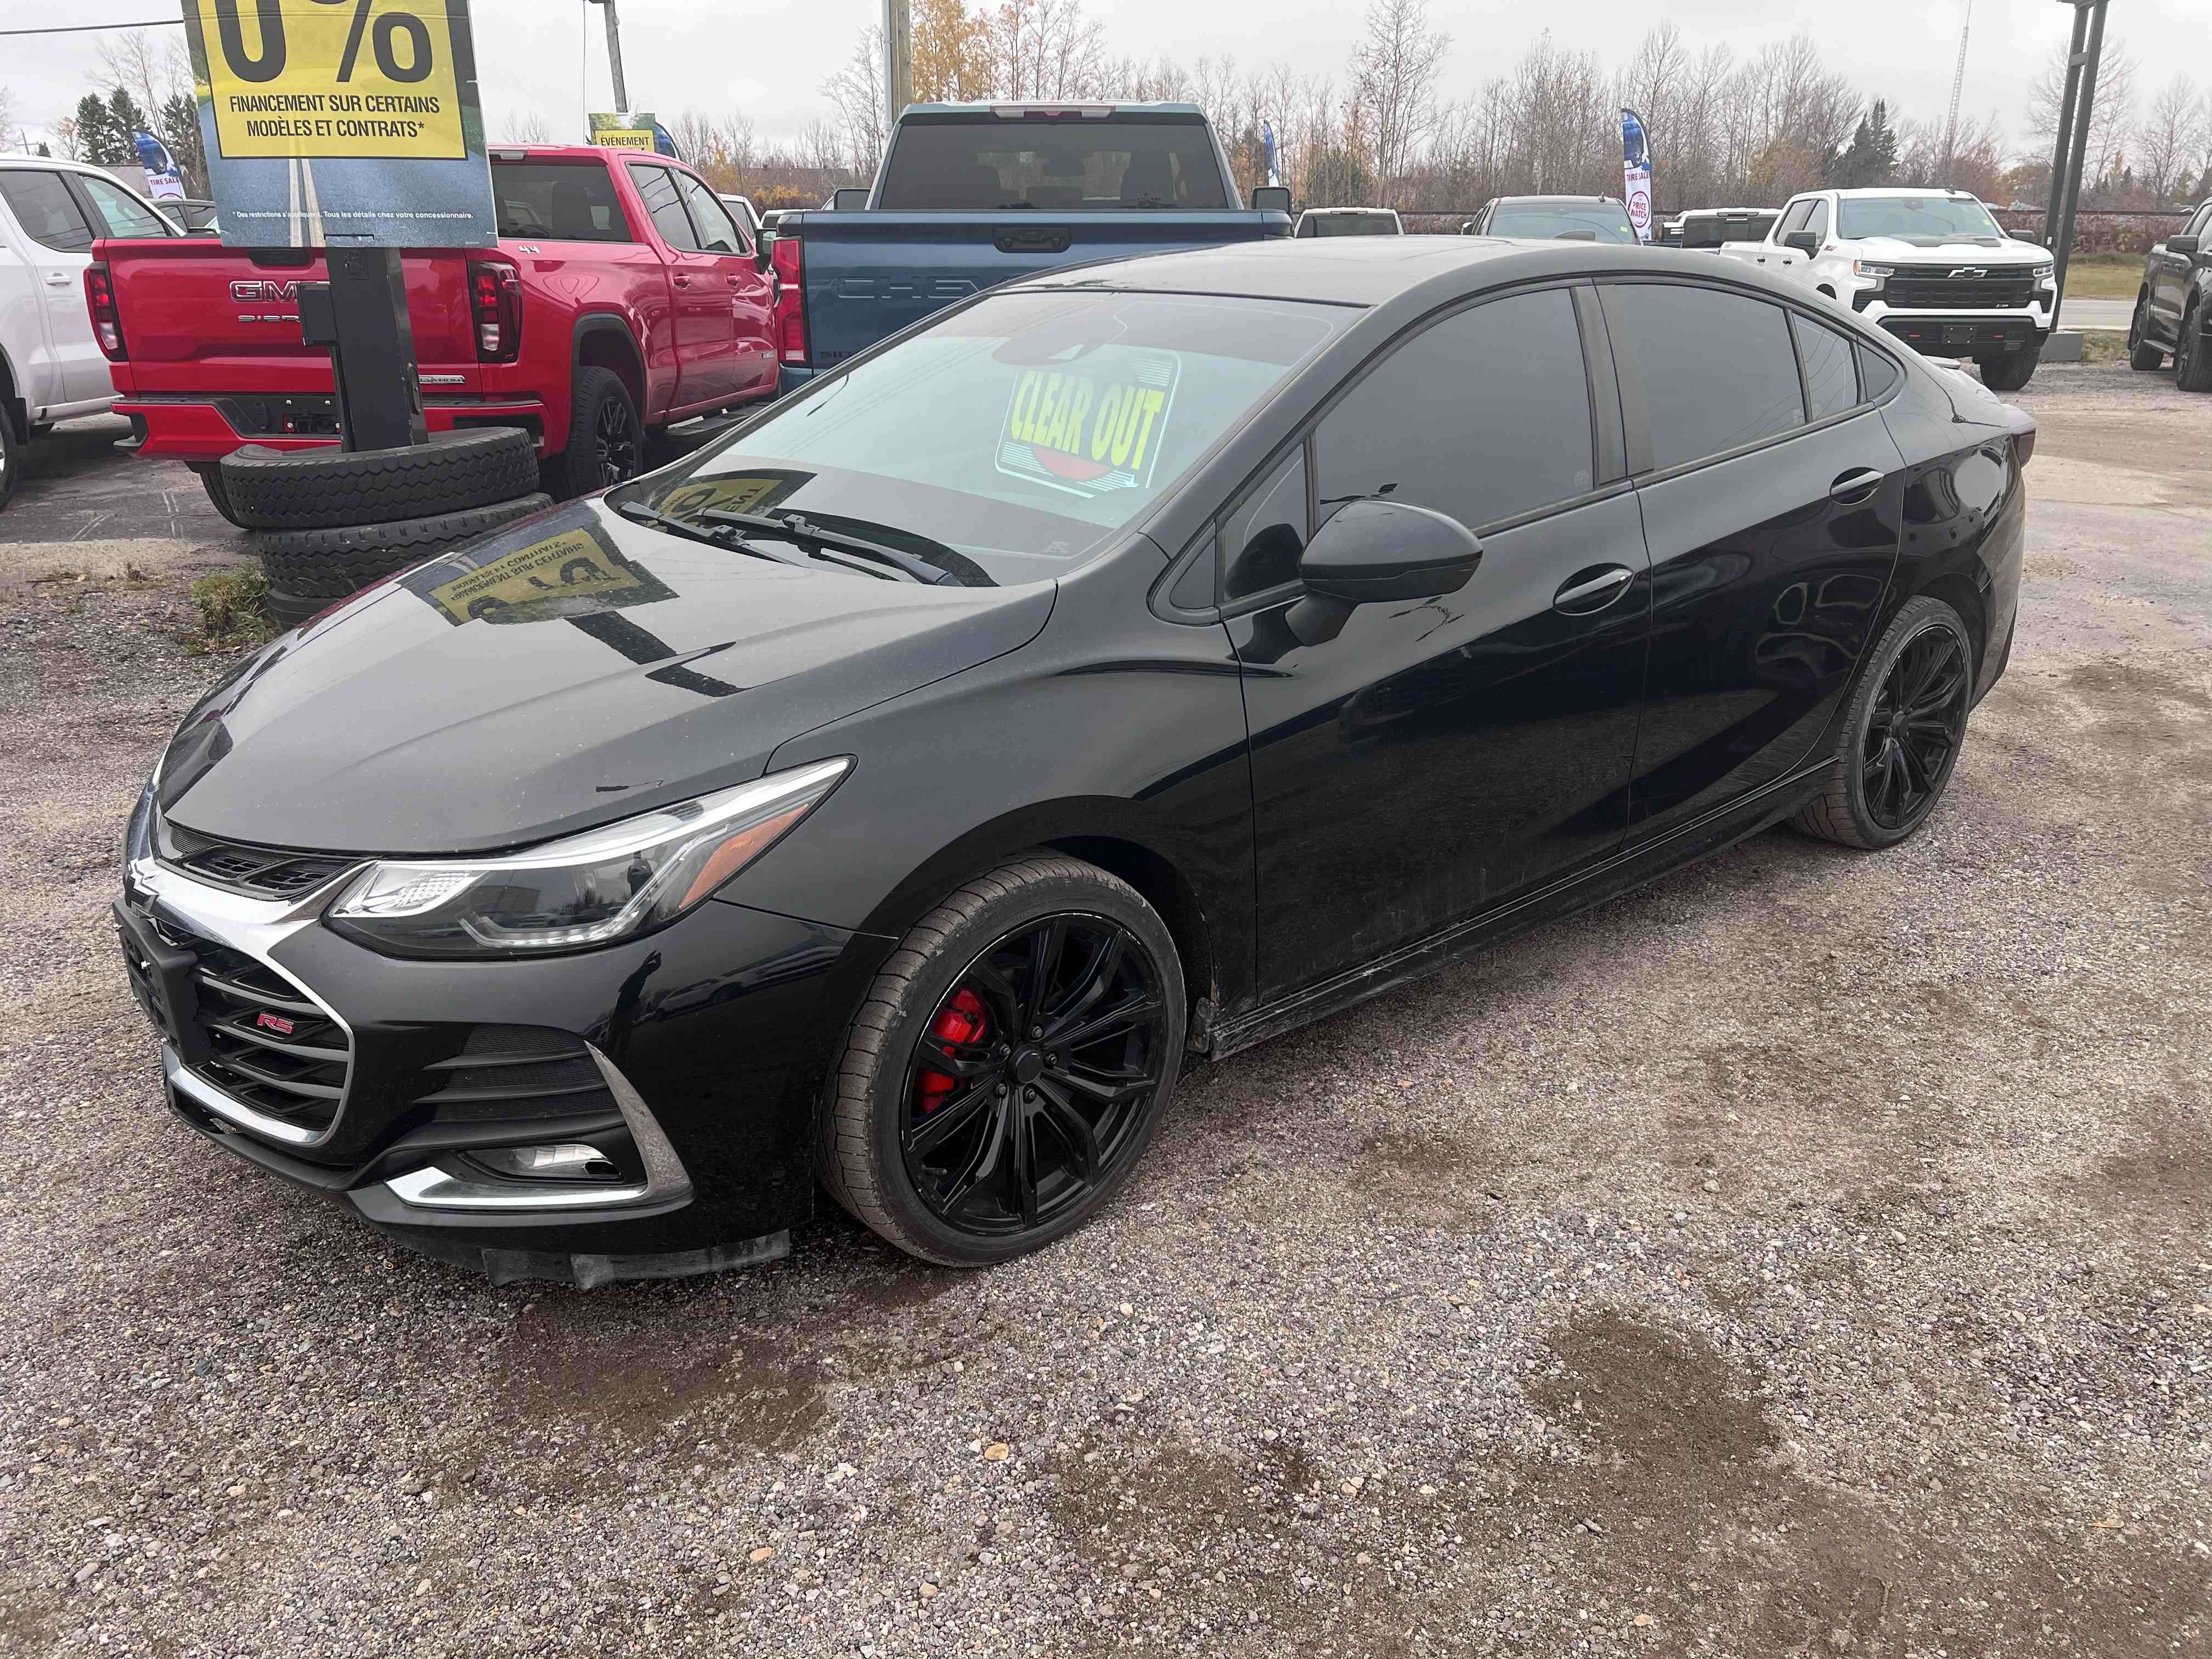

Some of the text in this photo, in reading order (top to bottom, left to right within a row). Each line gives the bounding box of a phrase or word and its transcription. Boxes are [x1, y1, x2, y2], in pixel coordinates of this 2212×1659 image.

[229, 94, 440, 114] FINANCEMENT SUR CERTAINS
[246, 115, 312, 137] MODÈLES
[315, 120, 332, 137] ET
[601, 135, 650, 146] ÉVÉNEMENT
[1630, 210, 1646, 219] MATCH
[1633, 201, 1646, 211] PRICE
[229, 280, 330, 302] GM
[1011, 370, 1165, 470] CLEAR OUT
[257, 1013, 294, 1034] RS
